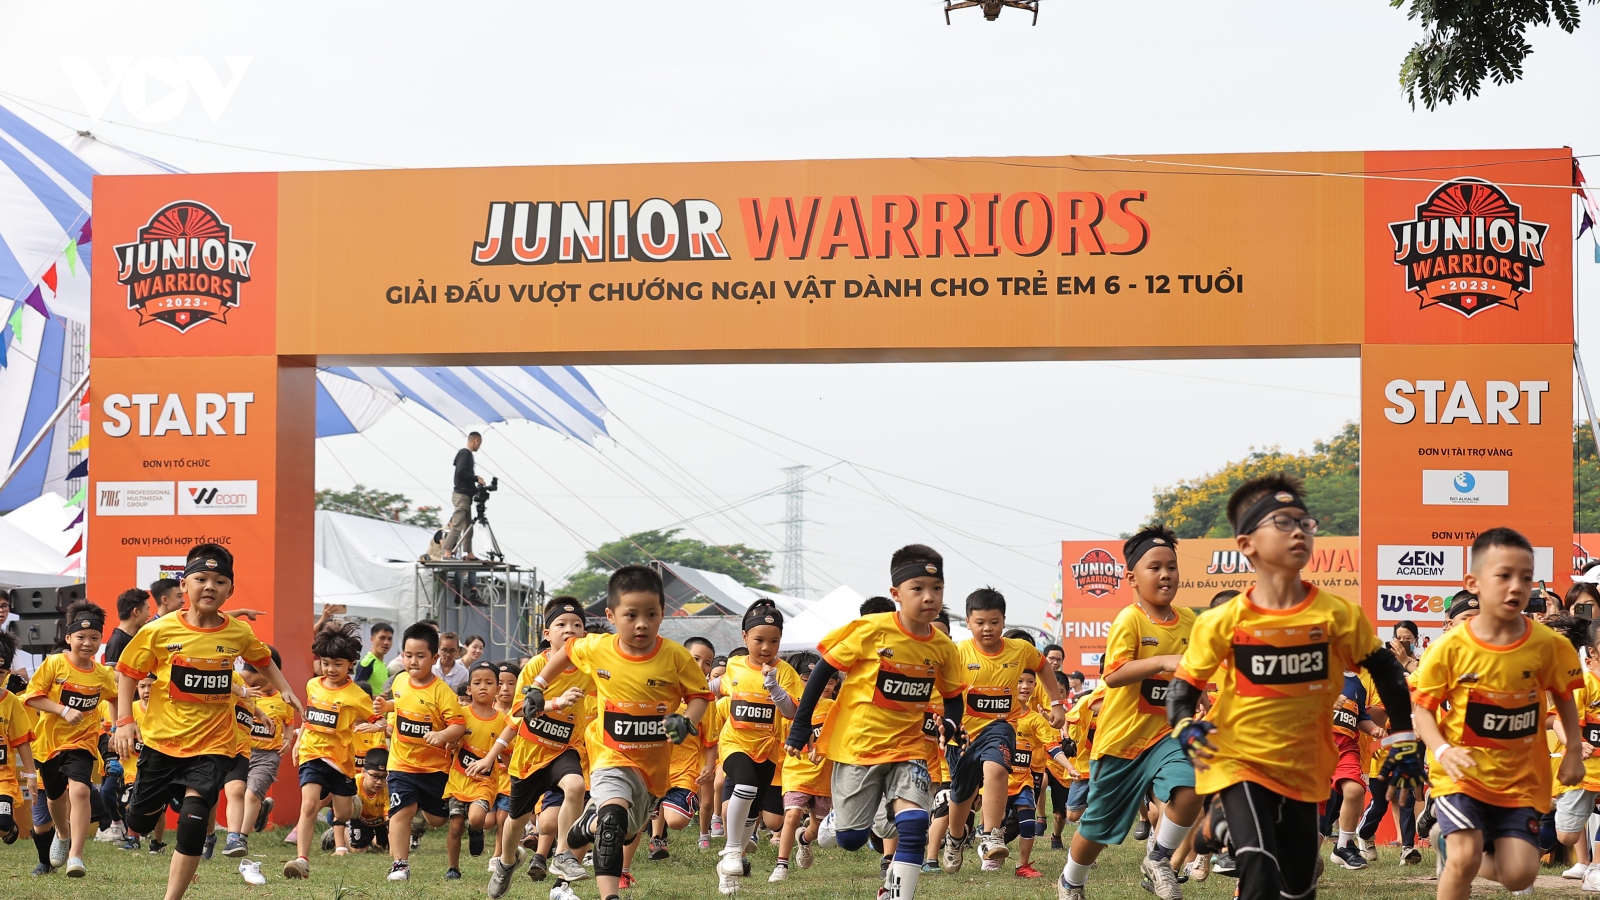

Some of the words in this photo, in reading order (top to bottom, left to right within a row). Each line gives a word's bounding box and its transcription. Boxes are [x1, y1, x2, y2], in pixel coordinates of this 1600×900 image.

[472, 198, 732, 265] JUNIOR
[738, 190, 1151, 260] WARRIORS
[1396, 217, 1543, 261] JUNIOR
[119, 238, 249, 281] JUNIOR
[1412, 253, 1524, 283] WARRIORS
[133, 272, 234, 300] WARRIORS
[386, 279, 437, 304] GIẢI
[444, 277, 501, 303] ĐẤU
[508, 280, 581, 307] VƯỢT
[588, 276, 703, 301] CHƯỚNG
[712, 280, 776, 305] NGẠI
[783, 274, 836, 304] VẬT
[844, 274, 922, 298] DÀNH
[930, 277, 989, 297] CHO
[996, 269, 1048, 297] TRẺ
[1057, 275, 1096, 295] EM
[1104, 275, 1121, 294] 6
[1145, 274, 1171, 294] 12
[1178, 266, 1243, 294] TUỔI
[1449, 280, 1489, 290] 2023
[165, 297, 201, 308] 2023
[1384, 379, 1549, 424] START
[102, 392, 255, 438] START
[1418, 448, 1439, 457] ĐƠN
[1441, 448, 1450, 458] VỊ
[1452, 447, 1467, 457] TÀI
[1468, 448, 1486, 459] TRỢ
[1487, 447, 1513, 457] VÀNG
[143, 459, 161, 468] ĐƠN
[164, 460, 172, 469] VỊ
[173, 457, 185, 468] TỔ
[186, 458, 210, 468] CHỨC
[122, 536, 141, 545] ĐƠN
[142, 537, 150, 547] VỊ
[152, 535, 173, 545] PHỐI
[1432, 532, 1453, 540] ĐƠN
[1455, 532, 1464, 542] VỊ
[1309, 549, 1359, 573] WA
[1074, 563, 1124, 578] JUNIOR
[1396, 567, 1445, 576] ACADEMY
[1079, 576, 1117, 586] WARRIORS
[1251, 650, 1323, 675] 671023
[184, 674, 229, 688] 671919
[883, 678, 931, 696] 670624
[735, 705, 772, 719] 670618
[977, 699, 1010, 709] 671162
[401, 722, 430, 734] 671915
[529, 717, 570, 738] 670665
[614, 720, 666, 736] 671092
[1483, 710, 1535, 731] 671601
